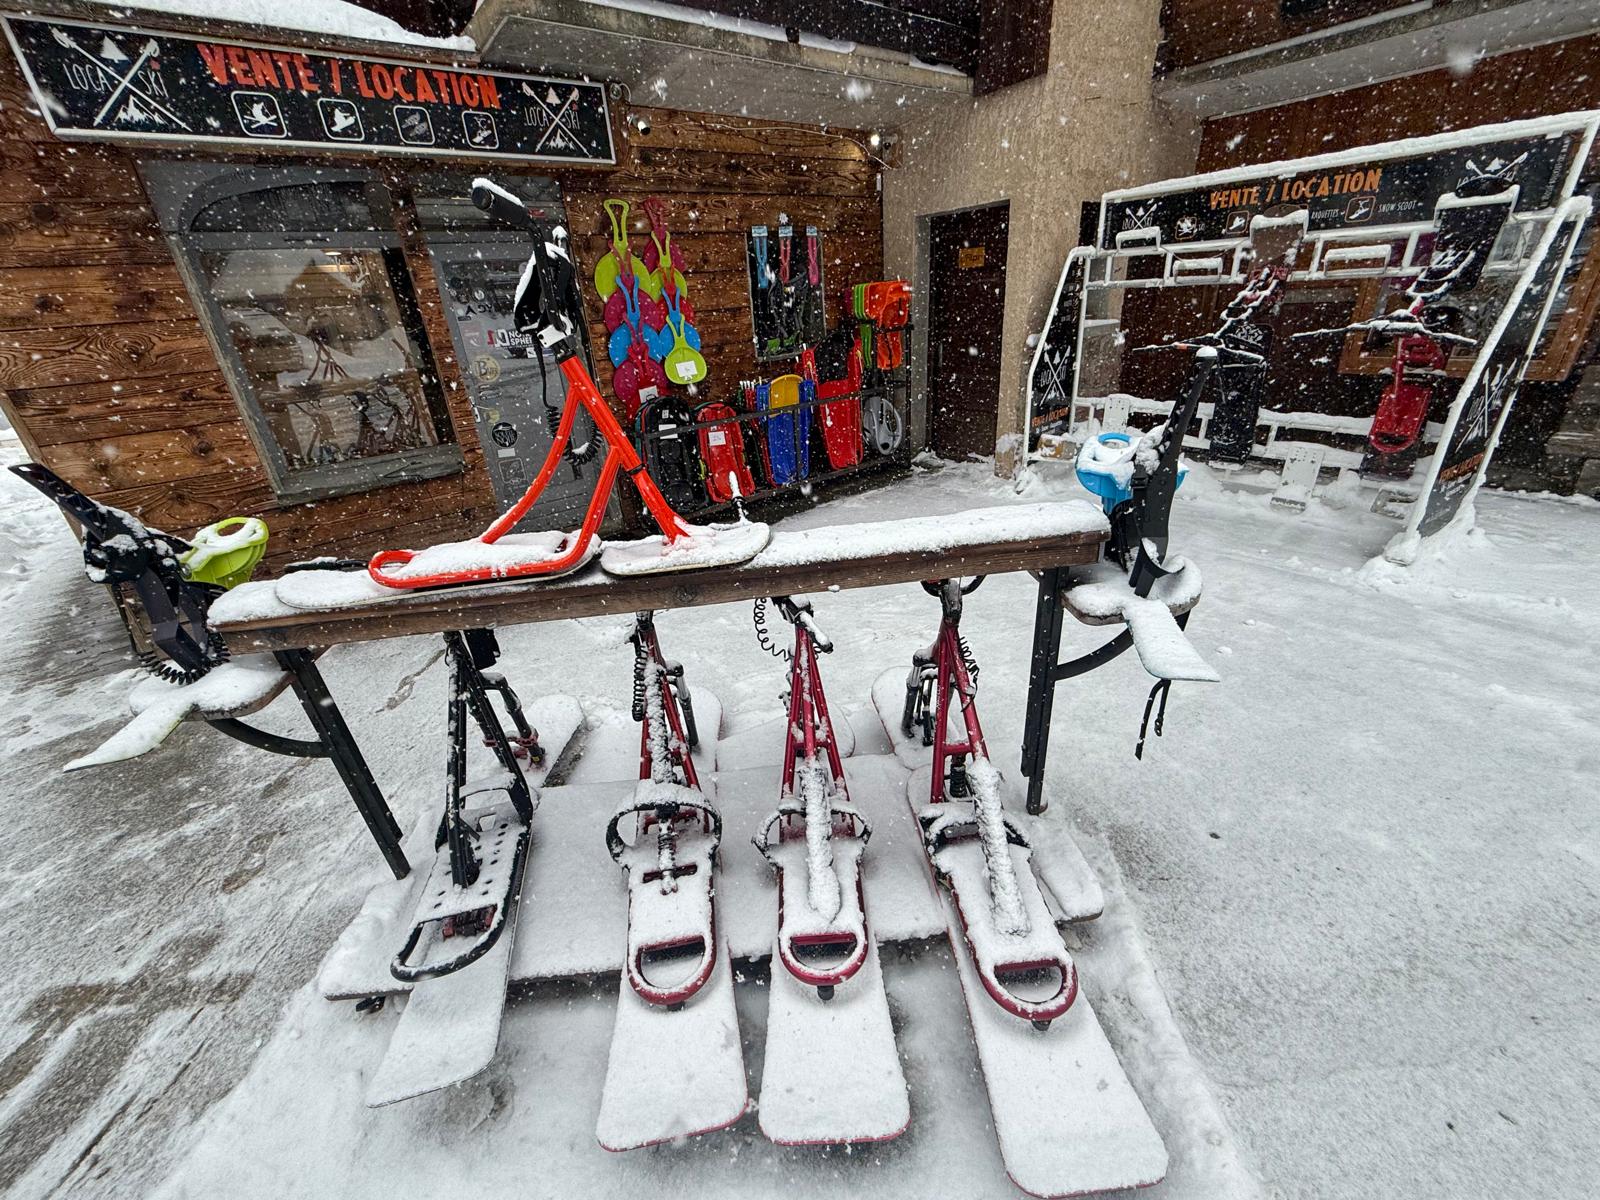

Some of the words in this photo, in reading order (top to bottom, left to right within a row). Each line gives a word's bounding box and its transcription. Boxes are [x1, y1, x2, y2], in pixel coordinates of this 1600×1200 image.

[63, 63, 113, 92] LOCA
[137, 70, 169, 98] SKI
[197, 44, 320, 92] VENTE
[331, 58, 342, 93] /
[354, 60, 502, 110] LOCATION
[524, 106, 550, 127] LOCA
[564, 109, 580, 130] SKI
[1211, 187, 1260, 210] VENTE
[1265, 183, 1276, 202] /
[1281, 168, 1383, 201] LOCATION
[1311, 209, 1340, 220] RAQUETTES
[1378, 203, 1396, 213] SNOW
[1397, 201, 1417, 212] SCOOT
